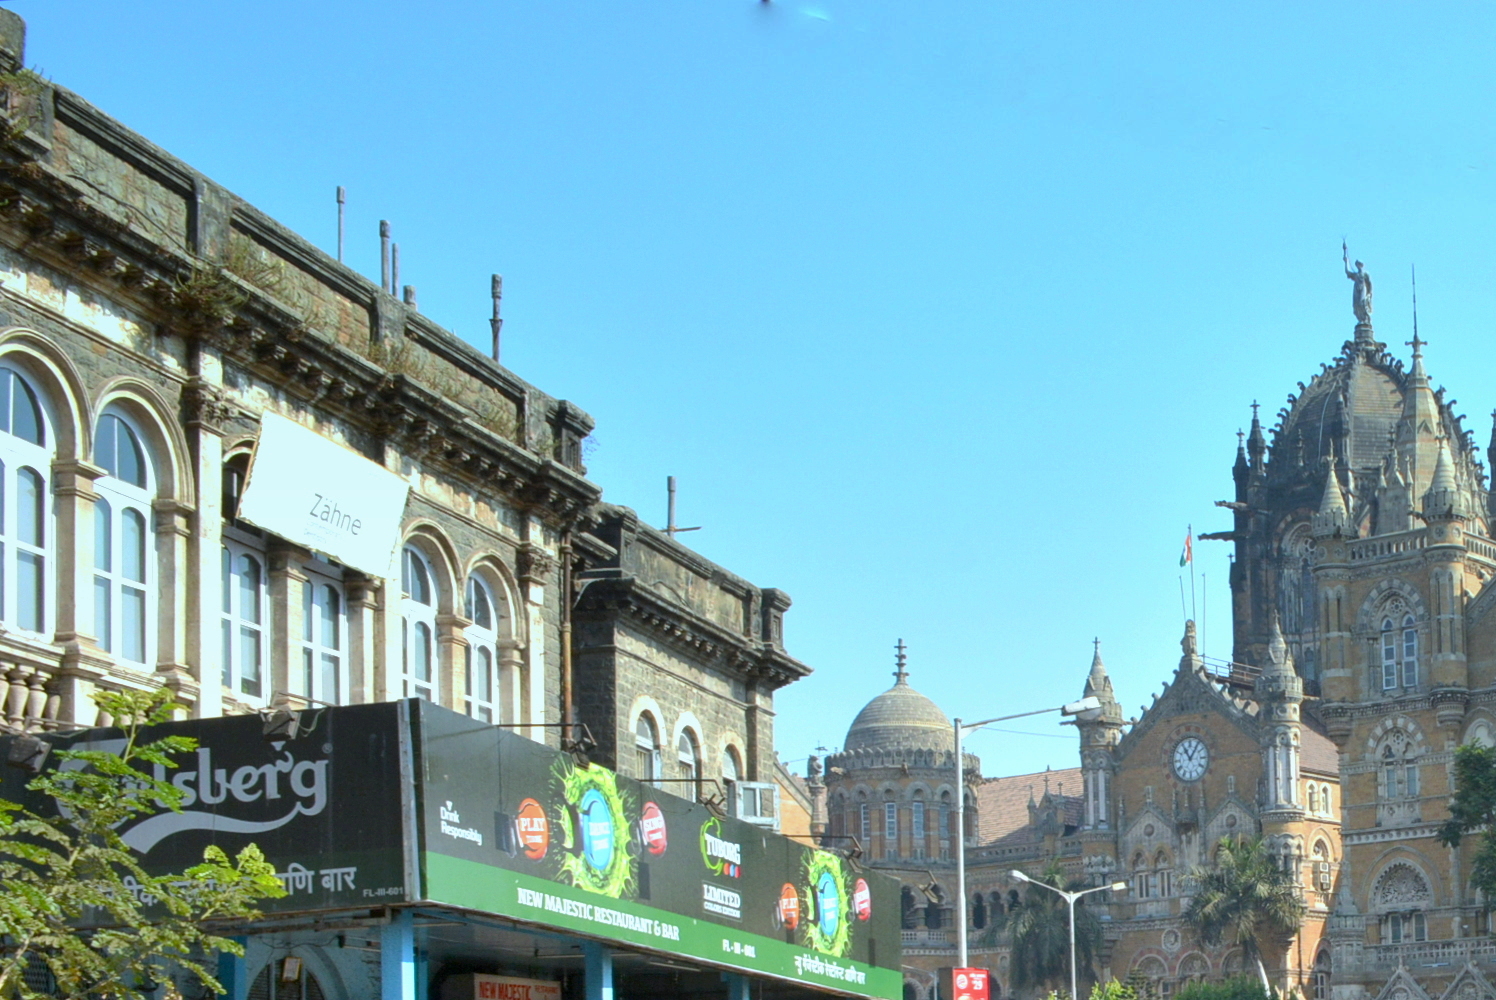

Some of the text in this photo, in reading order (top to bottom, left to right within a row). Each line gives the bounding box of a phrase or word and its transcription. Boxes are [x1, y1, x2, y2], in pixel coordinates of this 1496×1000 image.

[309, 493, 362, 536] Zähne
[440, 802, 460, 824] Drink
[520, 817, 546, 832] PLAY
[441, 820, 482, 846] Responsibly
[704, 832, 741, 865] TUBORG
[319, 866, 357, 893] बार
[703, 884, 741, 909] LIMITED
[517, 887, 680, 941] NEW MAJESTIC RESTAURANT & BAR
[479, 982, 532, 1000] NEW MAJESTIC
